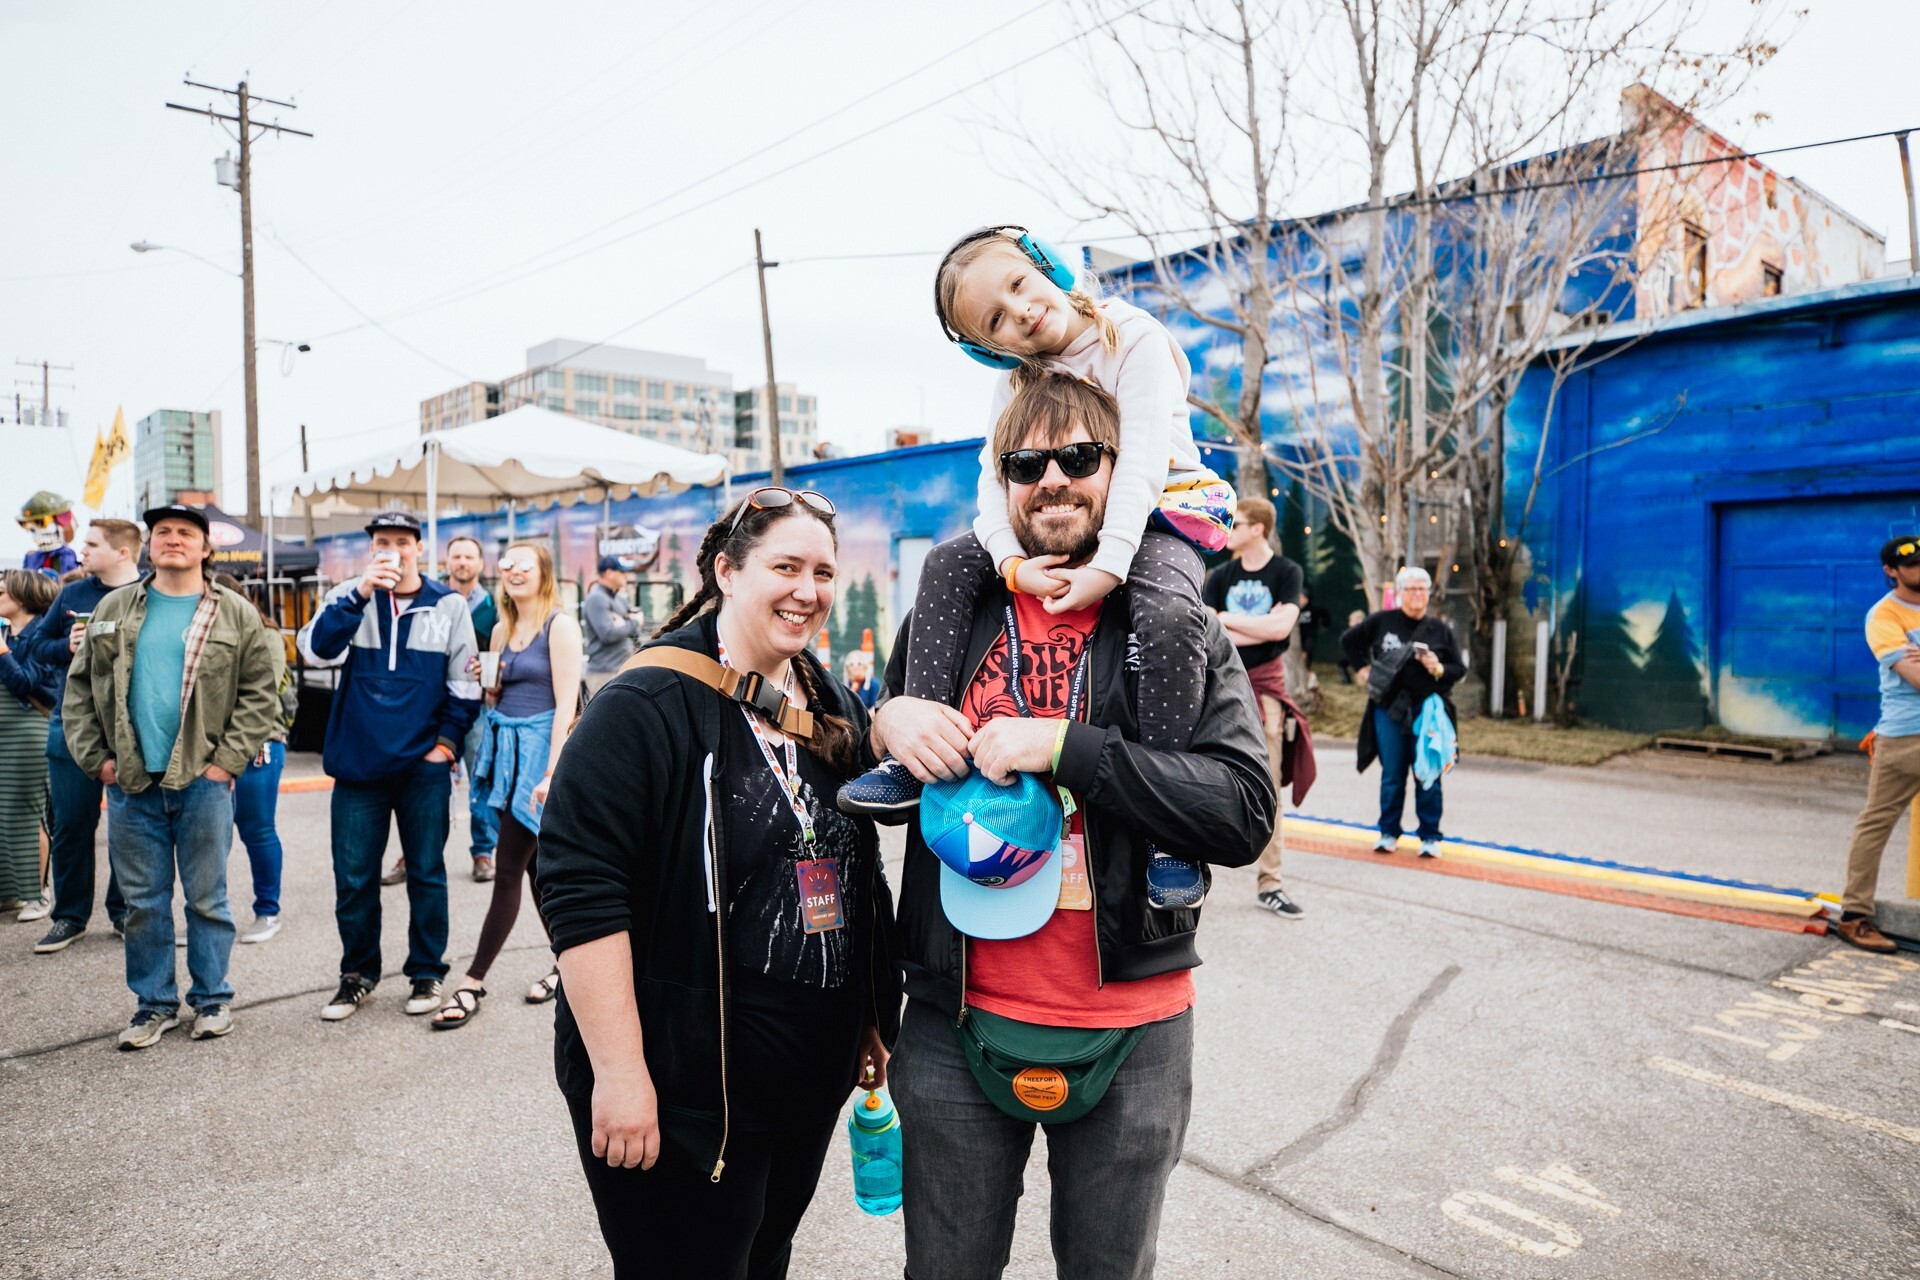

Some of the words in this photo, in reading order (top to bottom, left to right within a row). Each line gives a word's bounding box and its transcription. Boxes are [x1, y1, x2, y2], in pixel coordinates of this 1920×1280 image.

[421, 612, 452, 643] NY
[1005, 605, 1014, 627] DESIGN
[1011, 638, 1019, 669] SOFTWARE
[806, 893, 836, 908] STAFF
